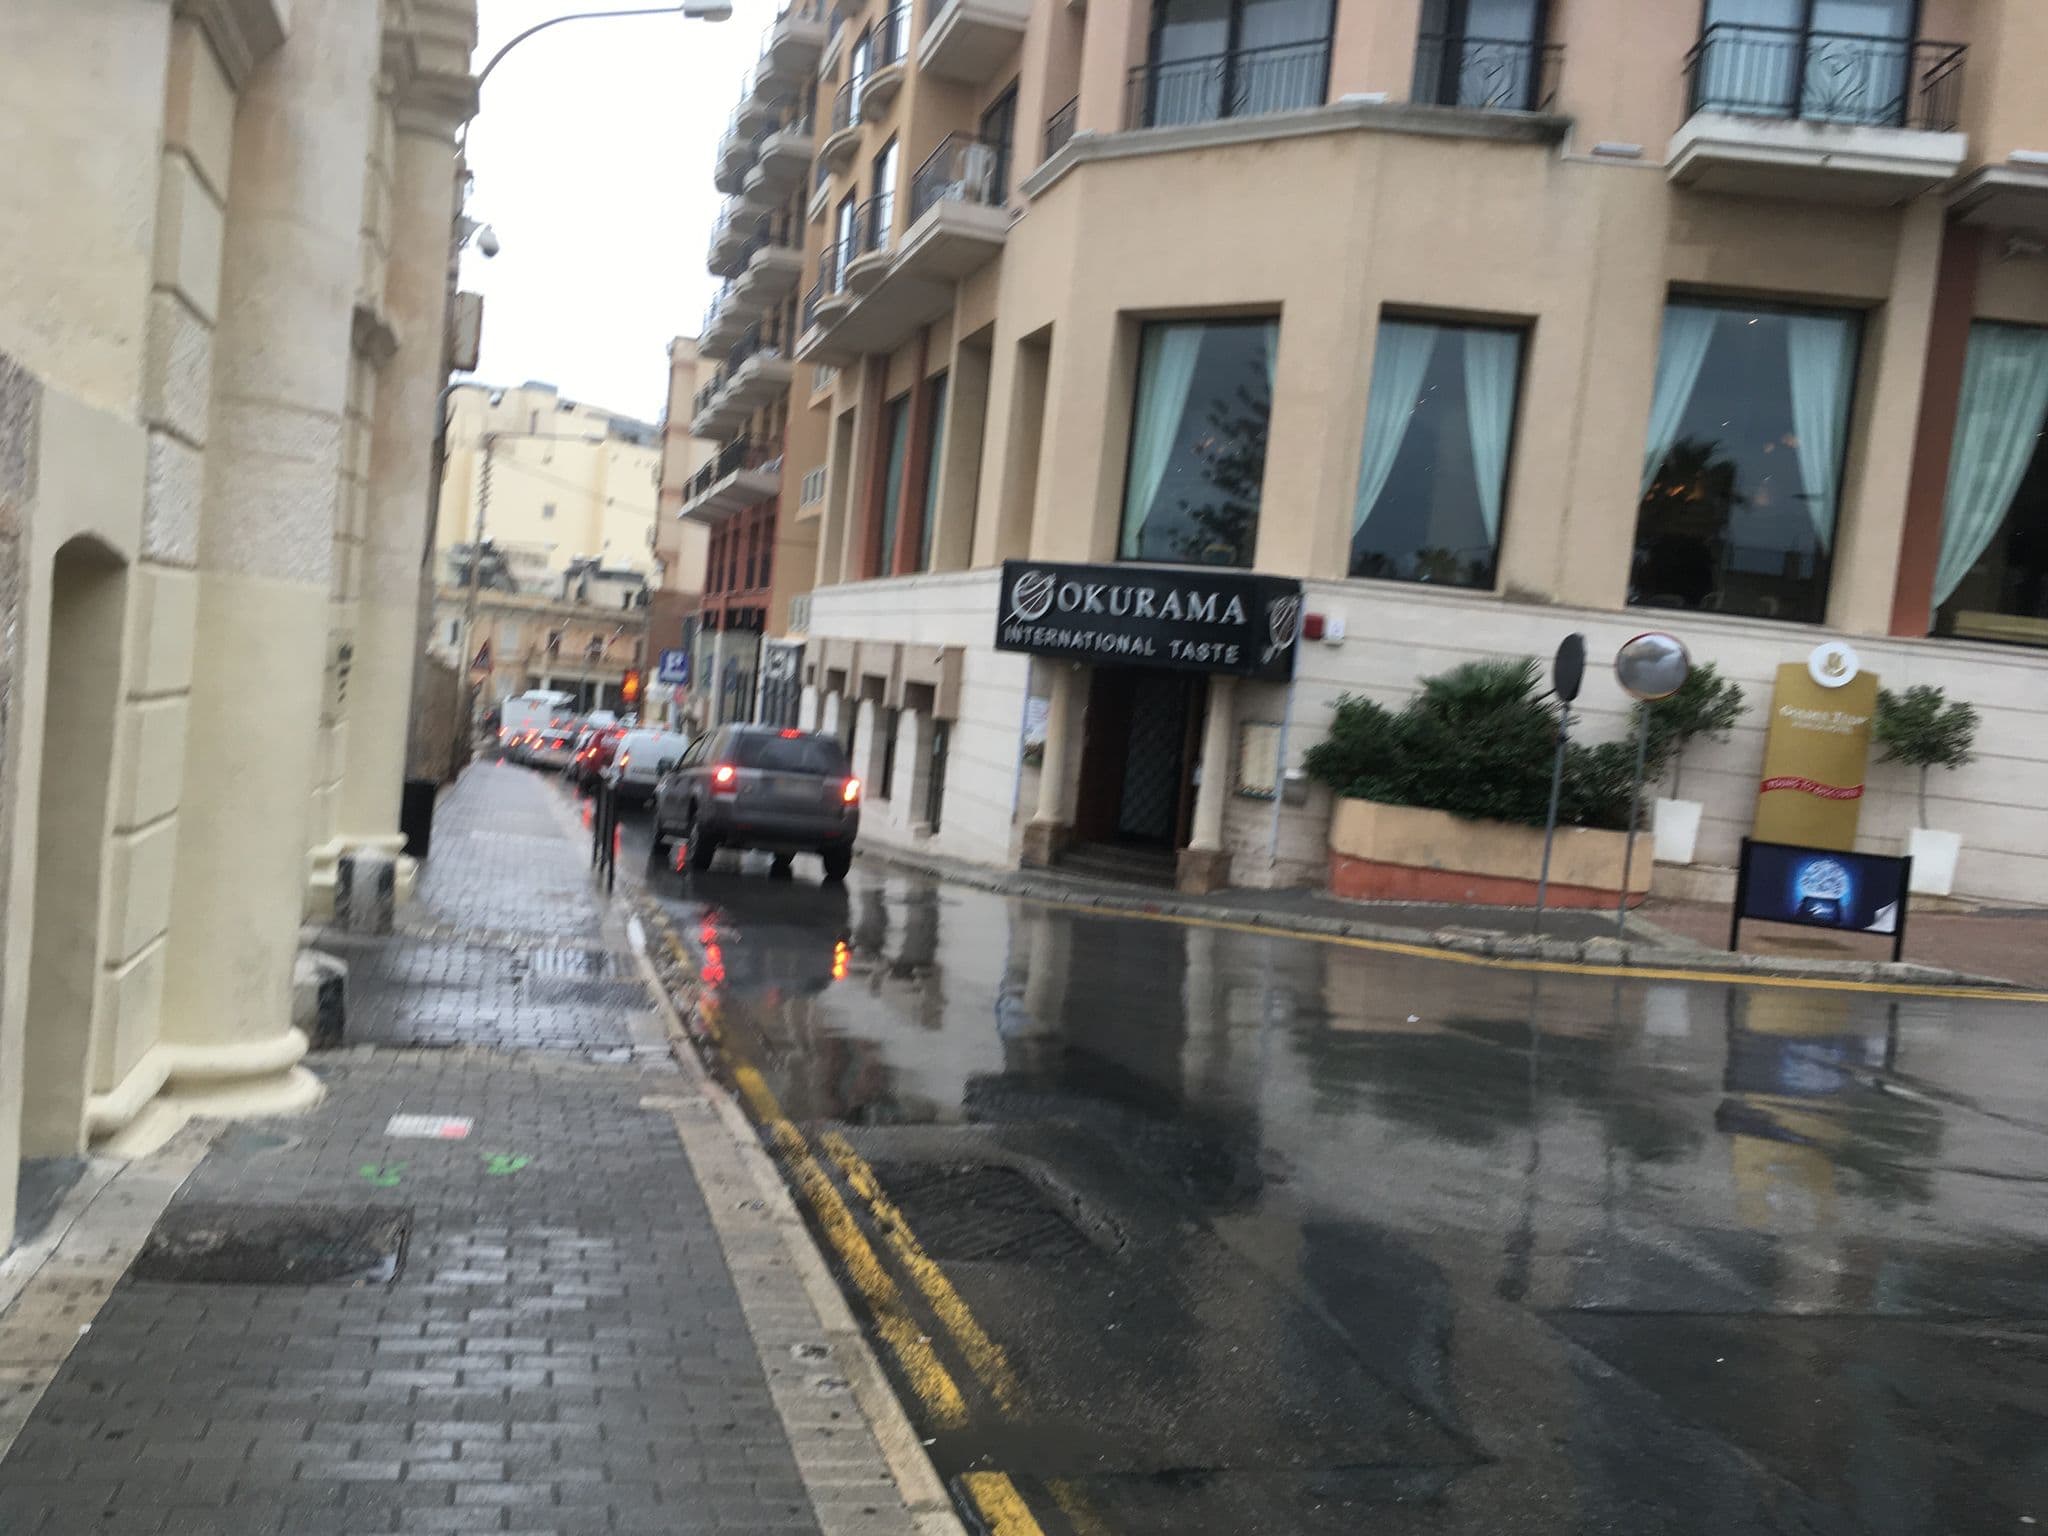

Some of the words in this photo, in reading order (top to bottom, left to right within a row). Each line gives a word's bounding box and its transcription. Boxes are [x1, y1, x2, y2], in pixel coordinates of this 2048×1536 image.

[1057, 581, 1247, 625] OKURAMA
[1004, 624, 1156, 656] INTERNATIONAL
[1168, 639, 1240, 664] TASTE
